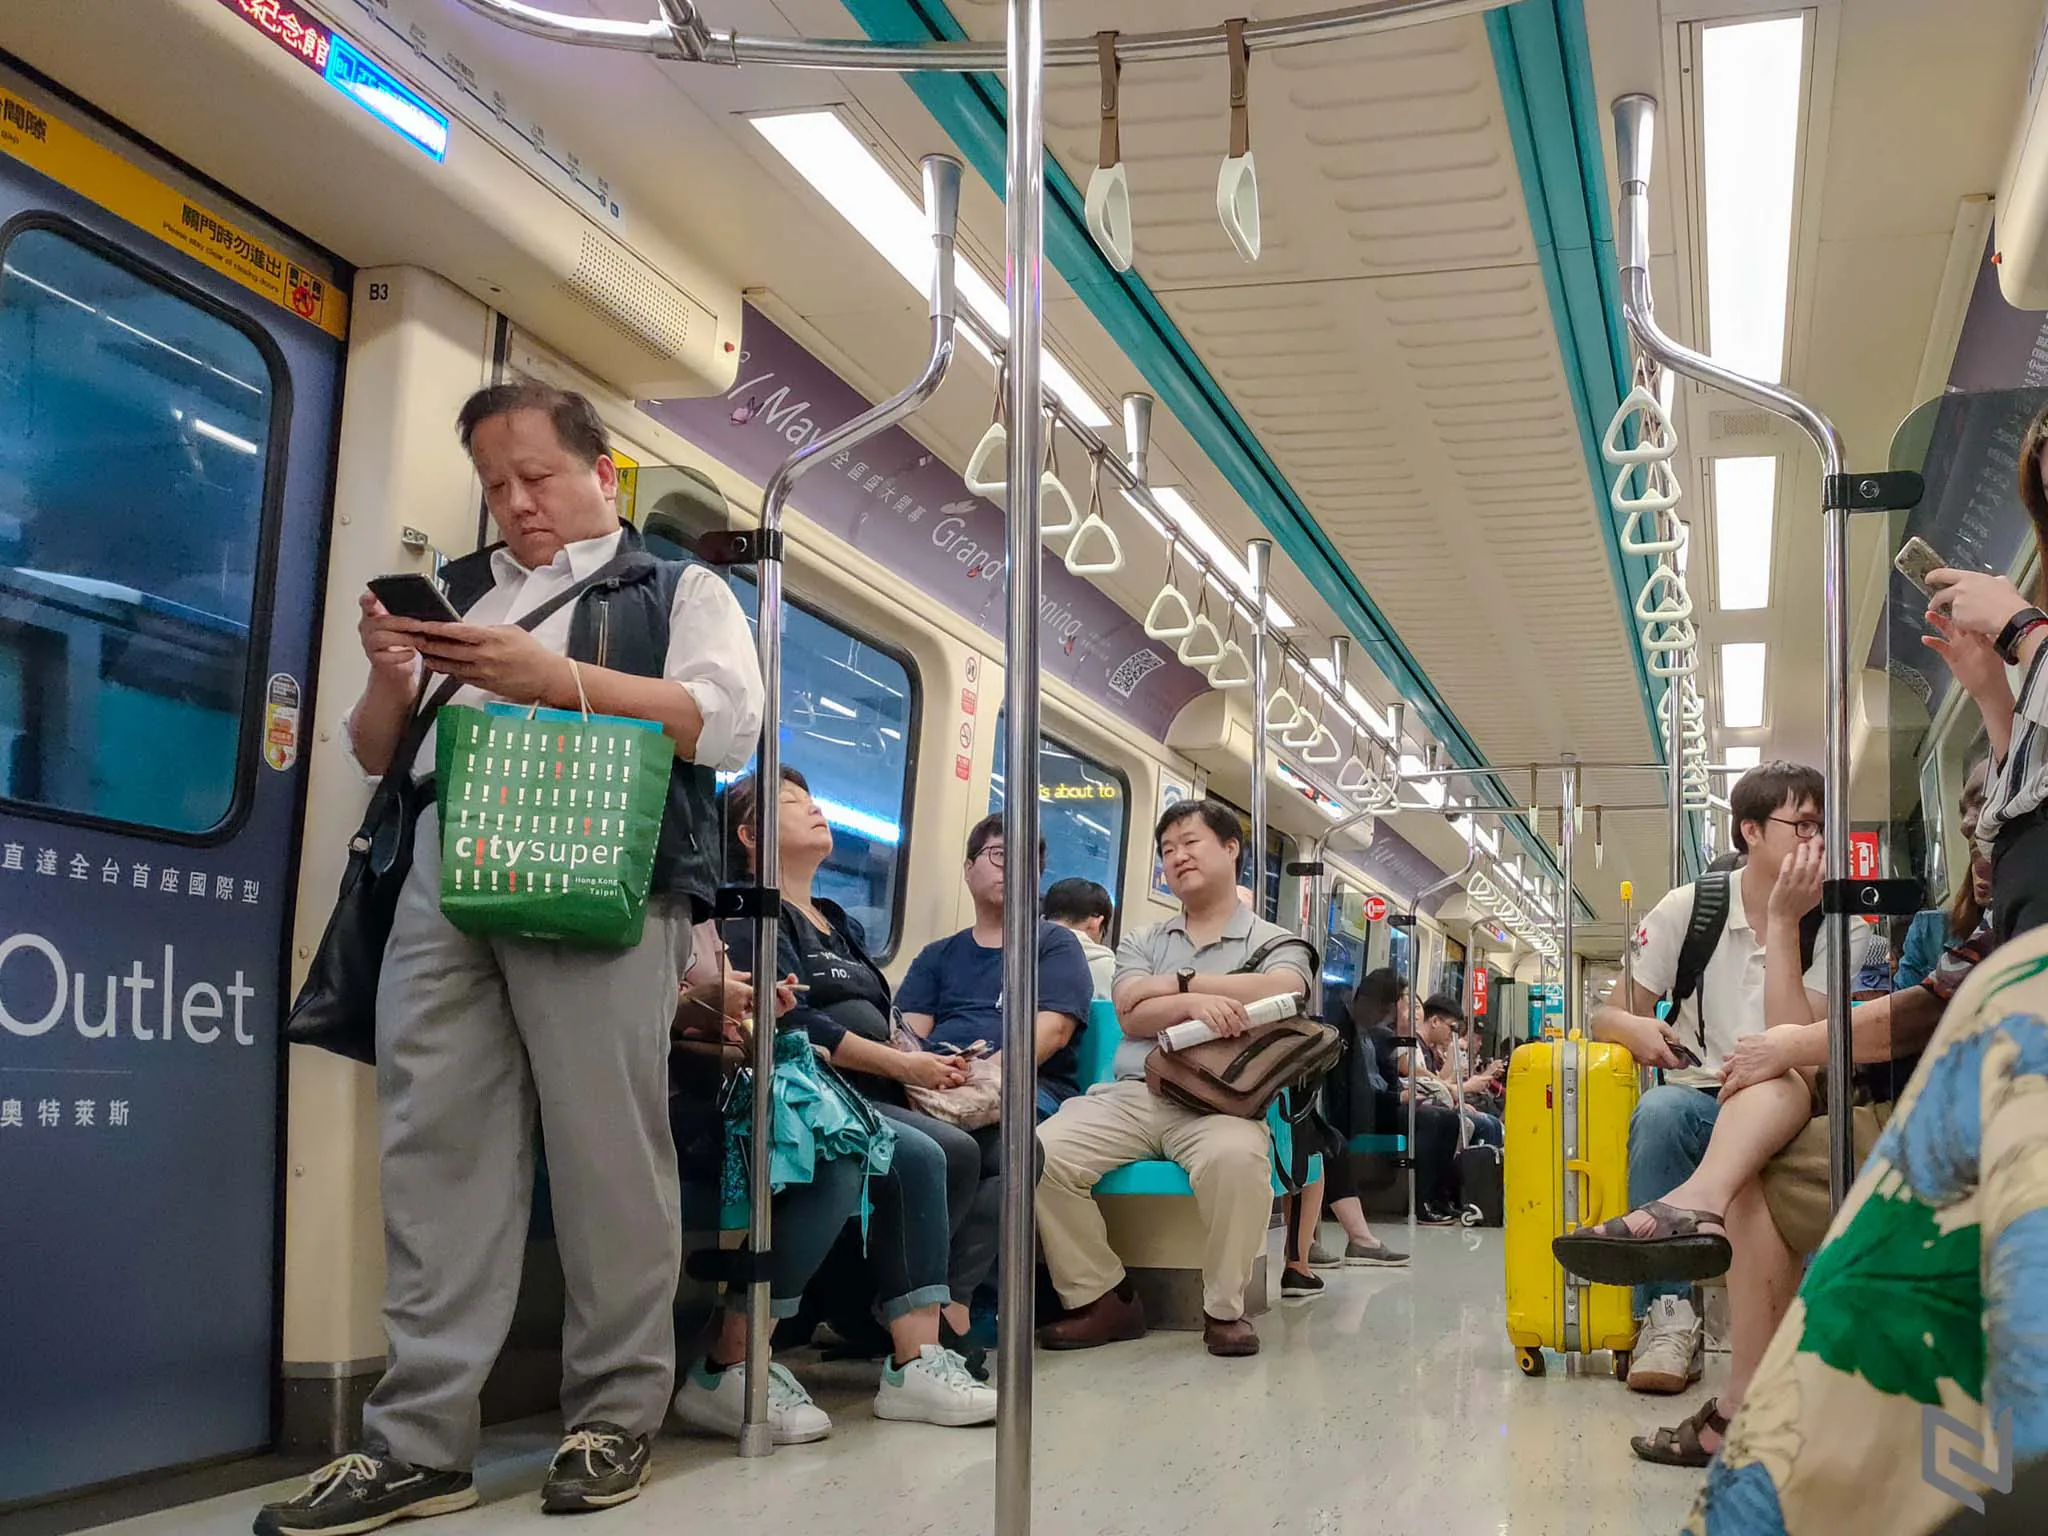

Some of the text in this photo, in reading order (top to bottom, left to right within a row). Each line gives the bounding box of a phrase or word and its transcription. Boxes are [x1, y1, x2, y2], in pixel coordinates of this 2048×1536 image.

[238, 0, 330, 67] 紀念館
[0, 97, 47, 143] 間隙
[369, 283, 389, 301] B3
[931, 517, 1005, 582] Grand
[1054, 783, 1094, 799] about
[1097, 783, 1116, 798] to
[1, 842, 260, 904] 直達全台首座國際型
[0, 932, 255, 1046] Outlet
[0, 1098, 130, 1127] 奧特萊斯
